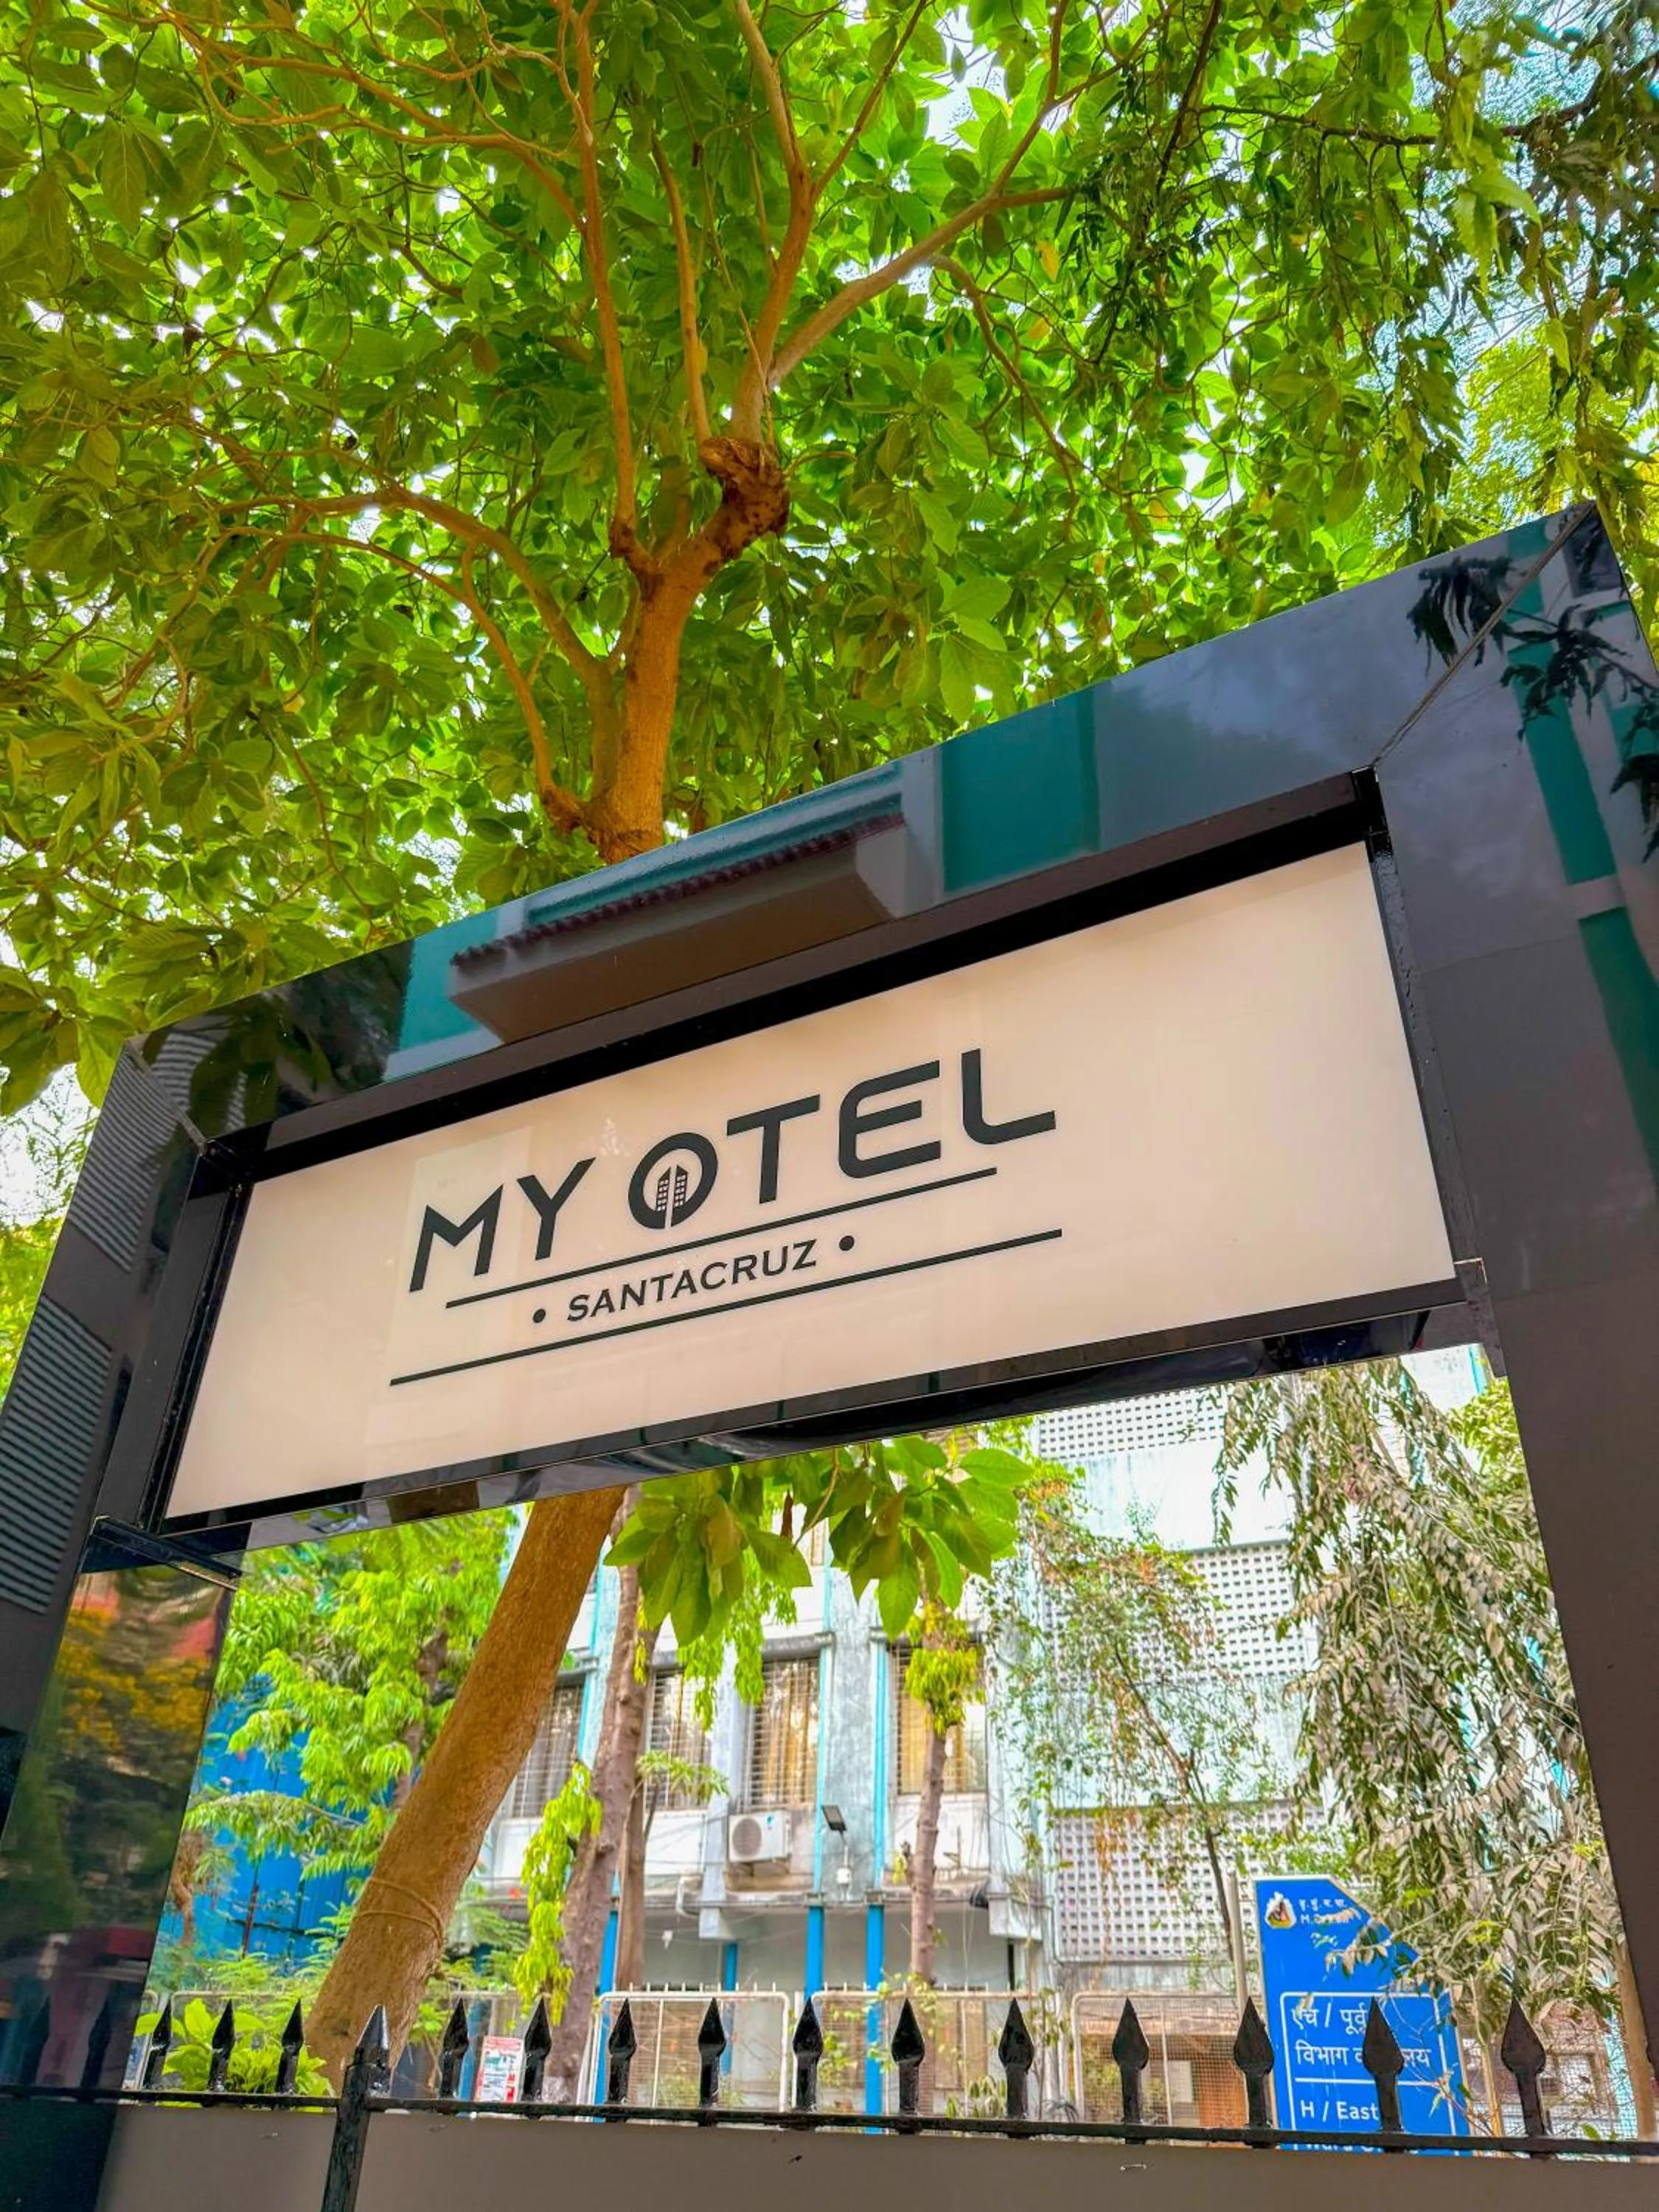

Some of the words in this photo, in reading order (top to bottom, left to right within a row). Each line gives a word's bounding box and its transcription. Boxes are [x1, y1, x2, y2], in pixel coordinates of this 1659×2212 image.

[408, 1157, 597, 1293] MY
[627, 1048, 1057, 1230] OTEL
[567, 1239, 817, 1322] SANTACRUZ
[1295, 2039, 1349, 2065] विभाग
[1300, 2100, 1315, 2118] H
[1322, 2101, 1329, 2123] /
[1336, 2100, 1380, 2121] East
